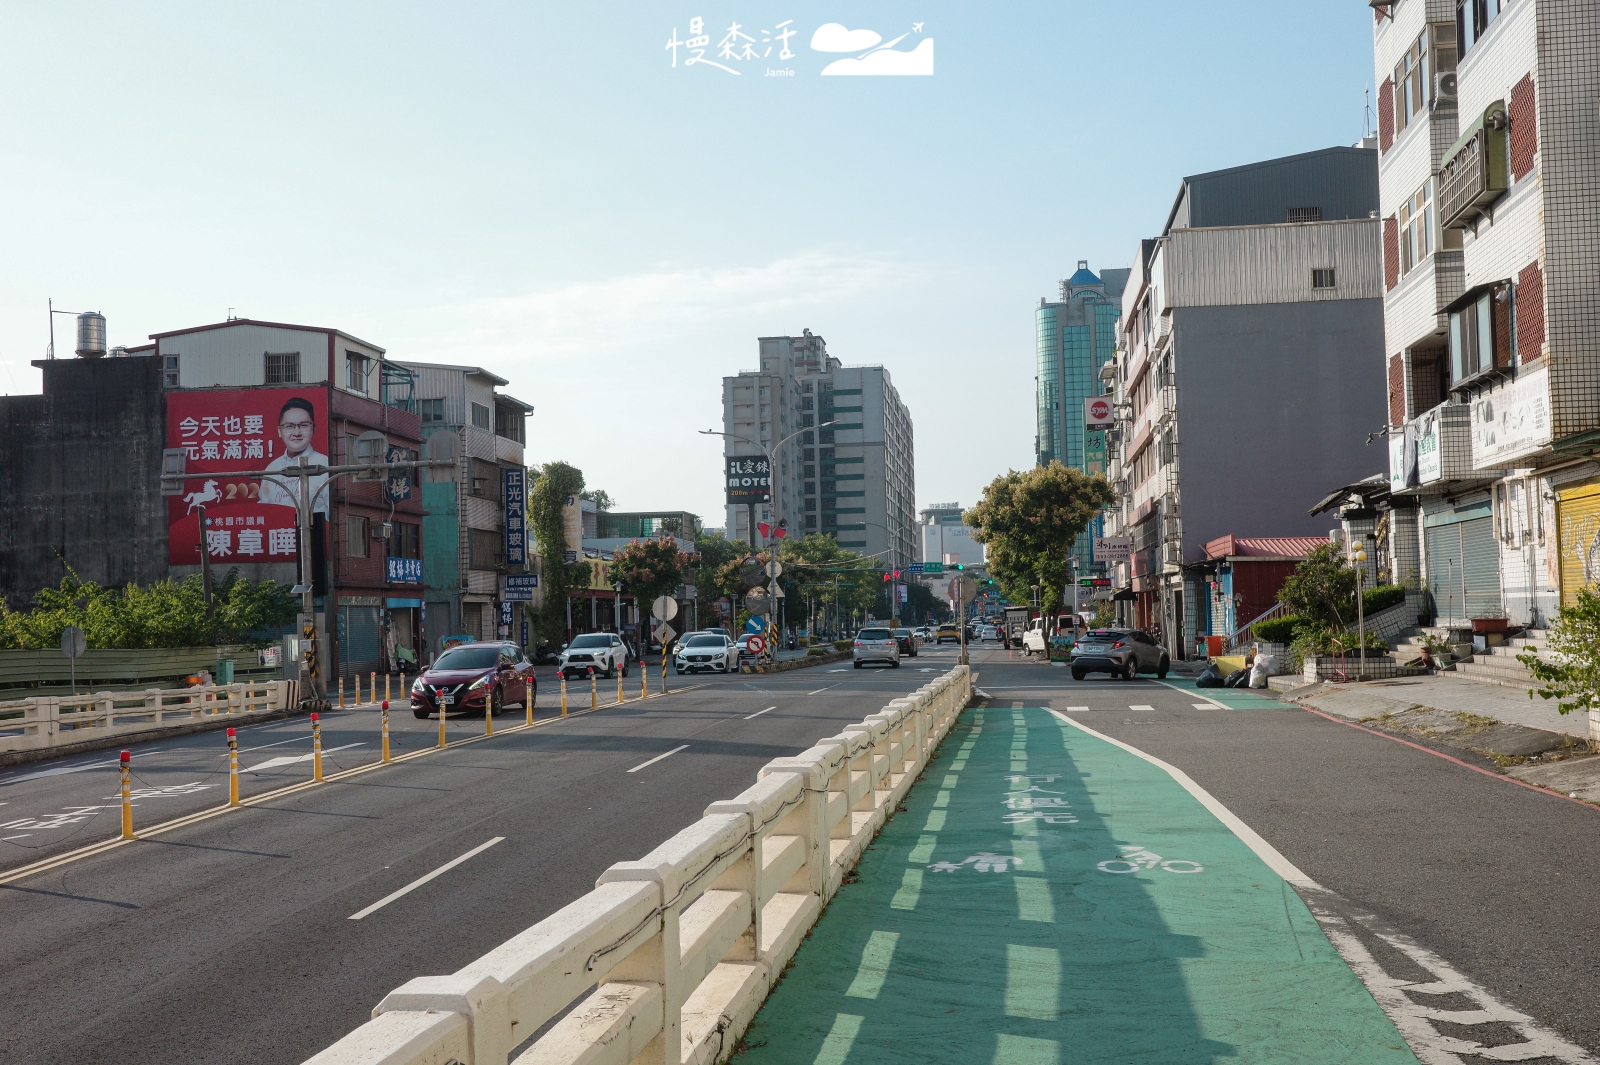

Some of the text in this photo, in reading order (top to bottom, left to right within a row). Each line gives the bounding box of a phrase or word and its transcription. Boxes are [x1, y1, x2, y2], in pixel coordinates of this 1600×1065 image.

[1091, 406, 1109, 416] SYM
[179, 415, 264, 437] 今天也要
[215, 516, 265, 527] 桃園市議員
[507, 471, 522, 562] 正光汽車玻璃
[1000, 774, 1079, 824] 行人優先
